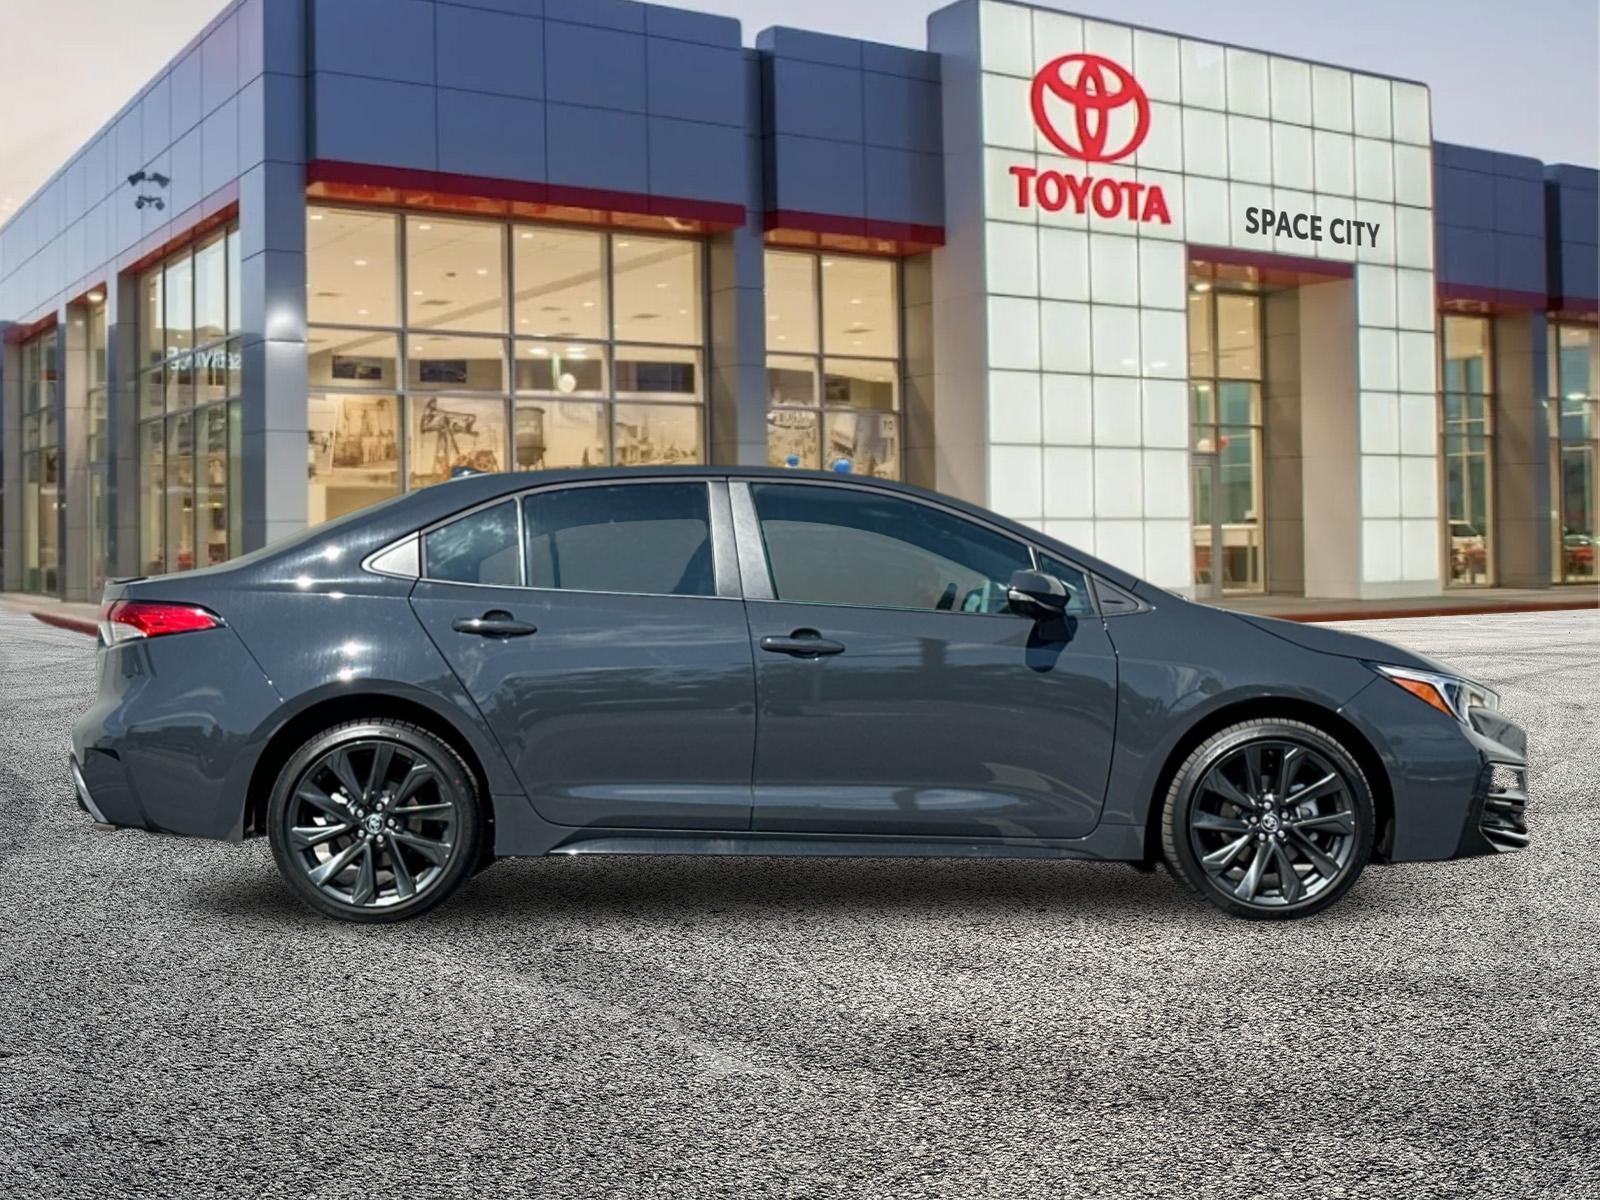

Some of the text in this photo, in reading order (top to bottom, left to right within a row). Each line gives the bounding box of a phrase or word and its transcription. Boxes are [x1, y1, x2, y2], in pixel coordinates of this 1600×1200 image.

[1009, 166, 1171, 225] TOYOTA
[1245, 206, 1380, 248] SPACE CITY
